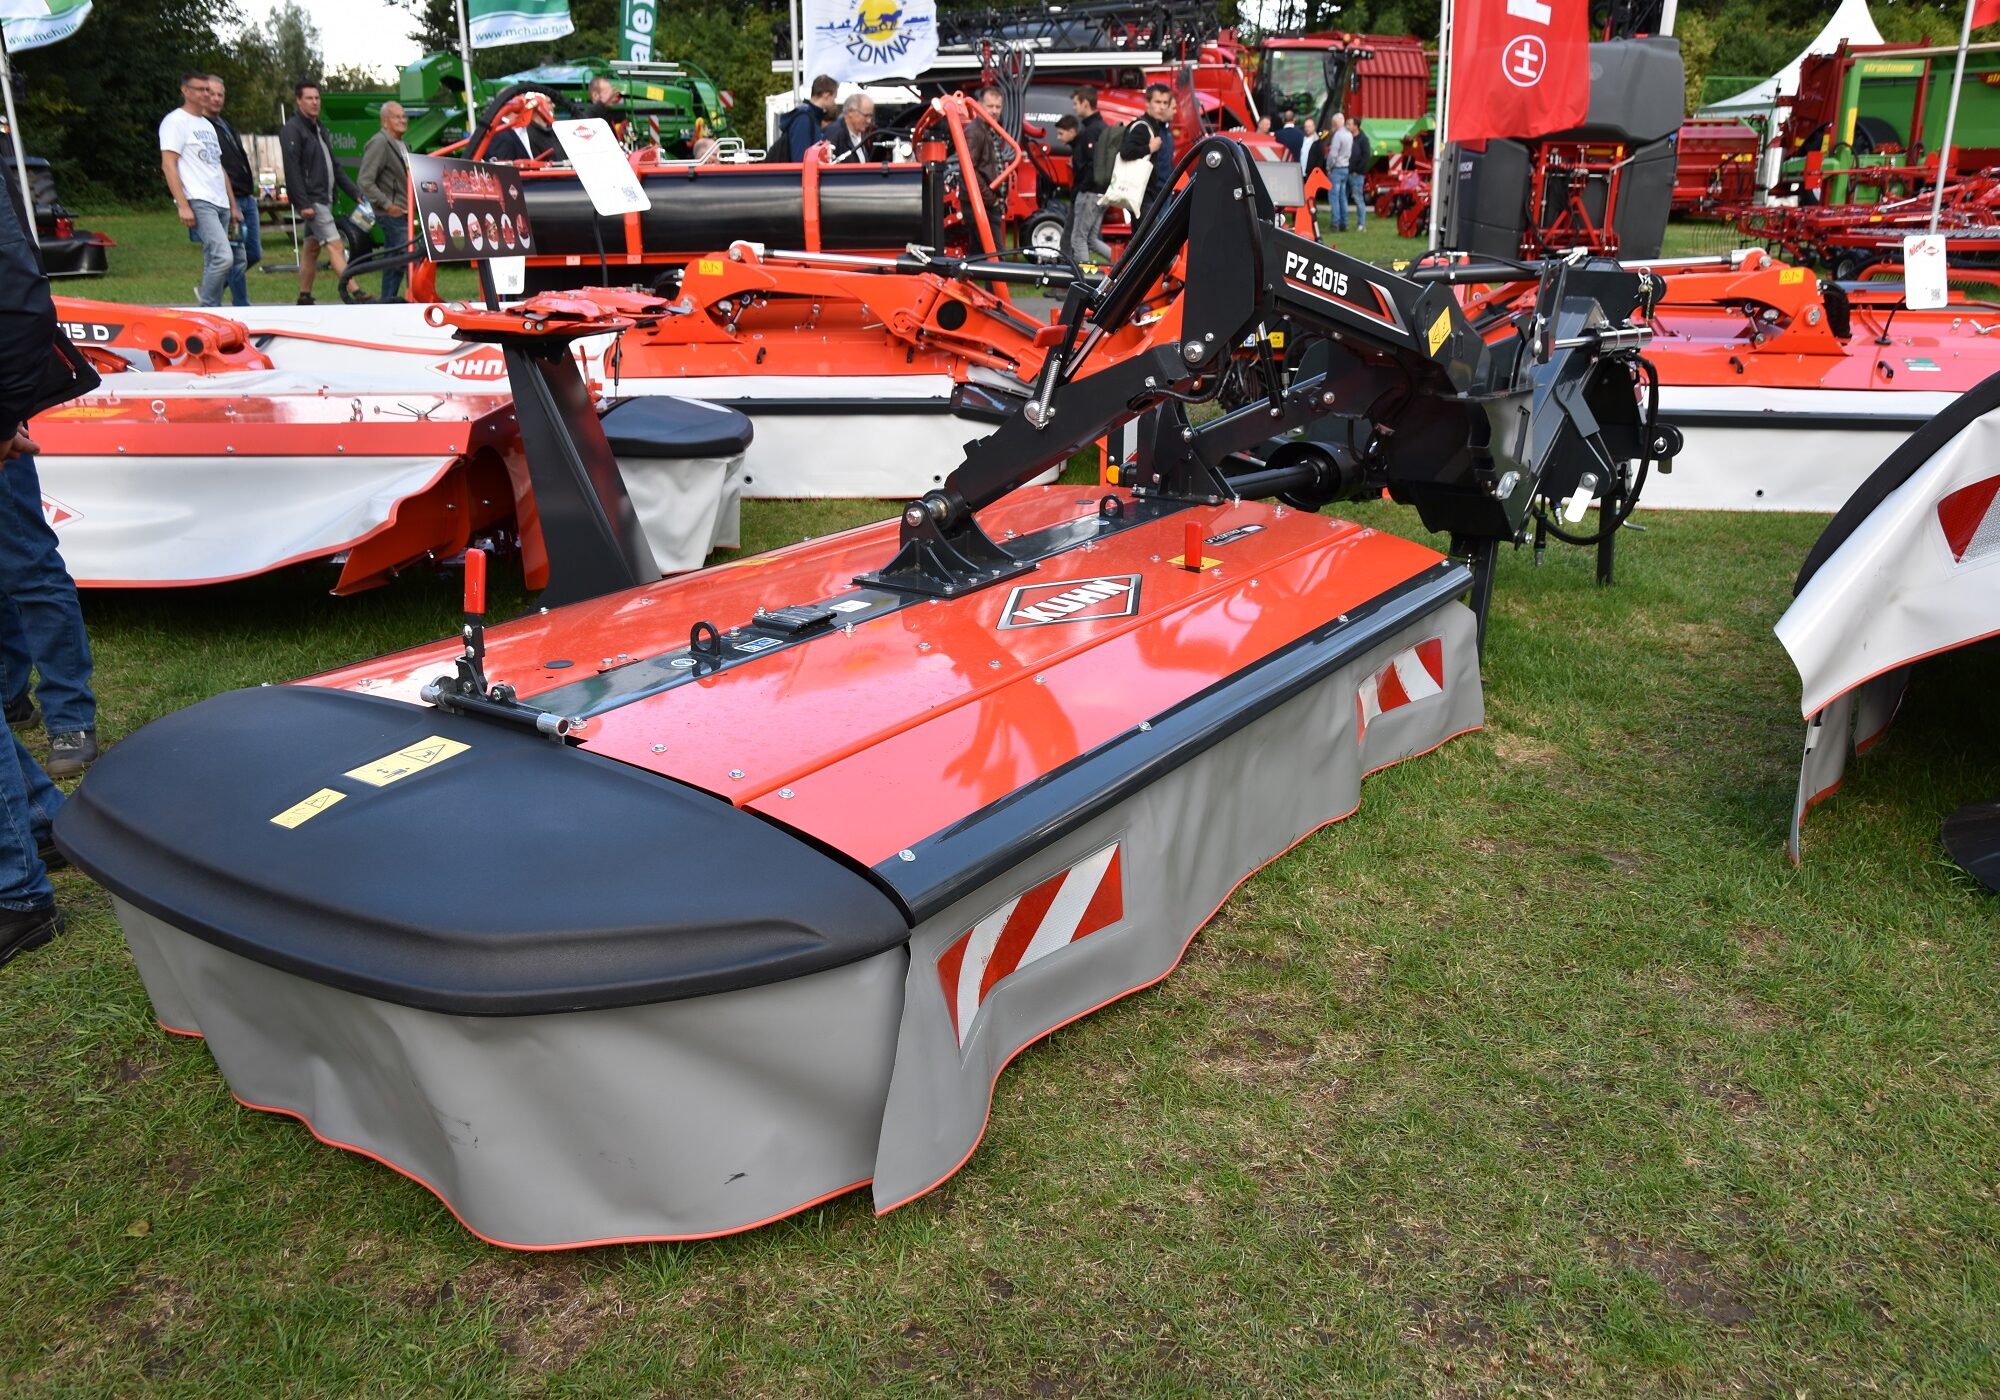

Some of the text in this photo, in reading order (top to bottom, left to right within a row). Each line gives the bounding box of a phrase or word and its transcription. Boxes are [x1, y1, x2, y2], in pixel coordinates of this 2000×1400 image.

[475, 24, 570, 42] www.mchale.net
[1284, 250, 1349, 297] PZ 3015
[92, 324, 110, 341] D
[1011, 579, 1133, 623] KUHN
